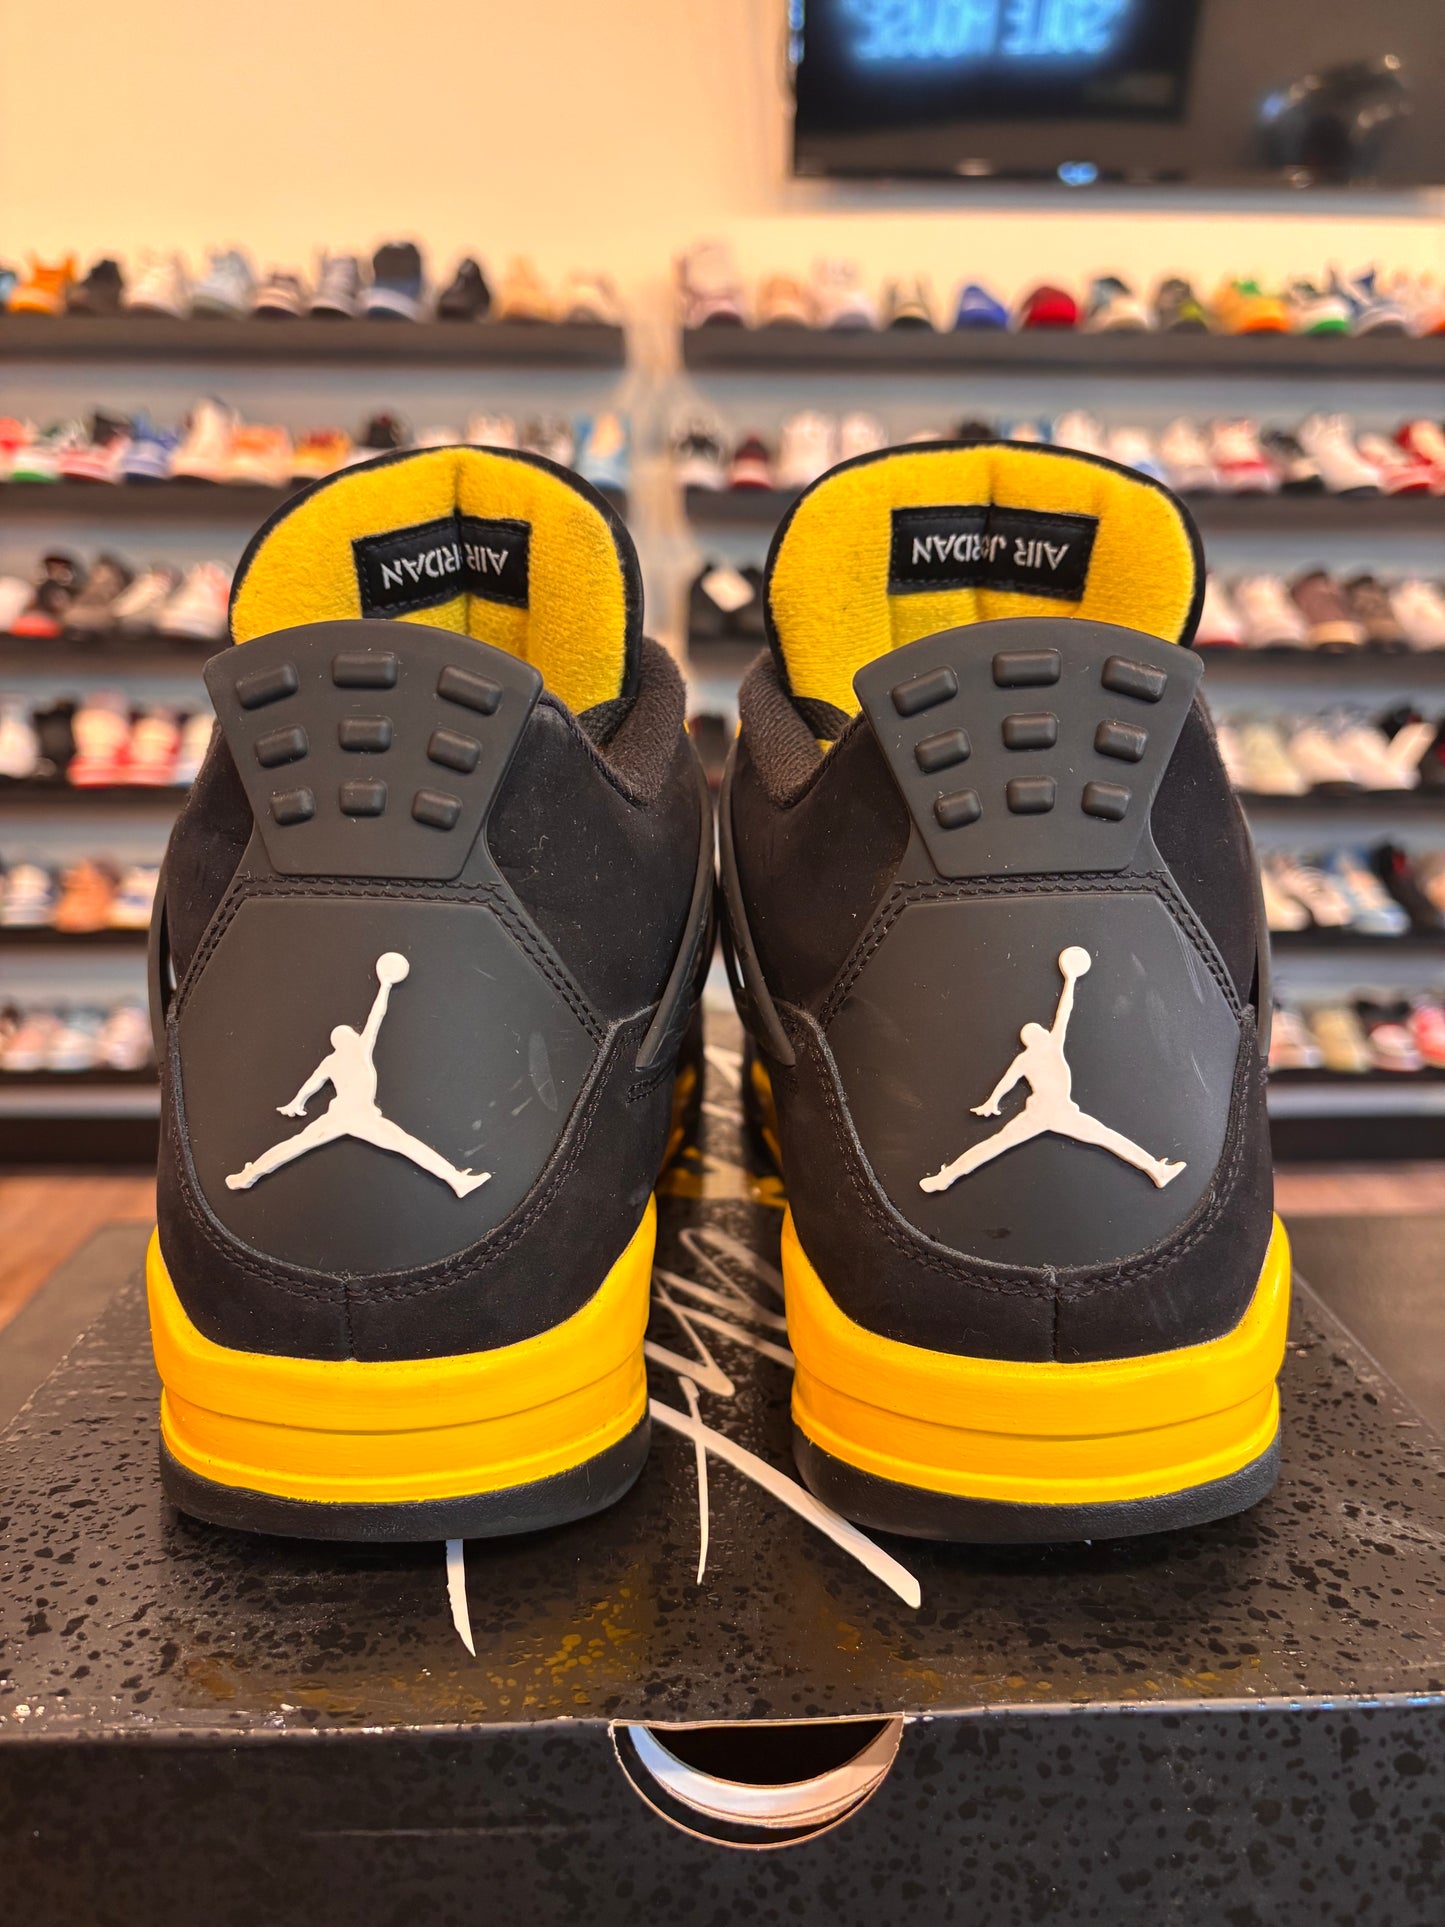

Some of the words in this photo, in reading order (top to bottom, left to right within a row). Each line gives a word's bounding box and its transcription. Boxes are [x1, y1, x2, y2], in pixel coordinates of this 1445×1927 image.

[380, 542, 463, 590] RDAN
[465, 543, 509, 576] AIR
[1013, 537, 1070, 571] AIR
